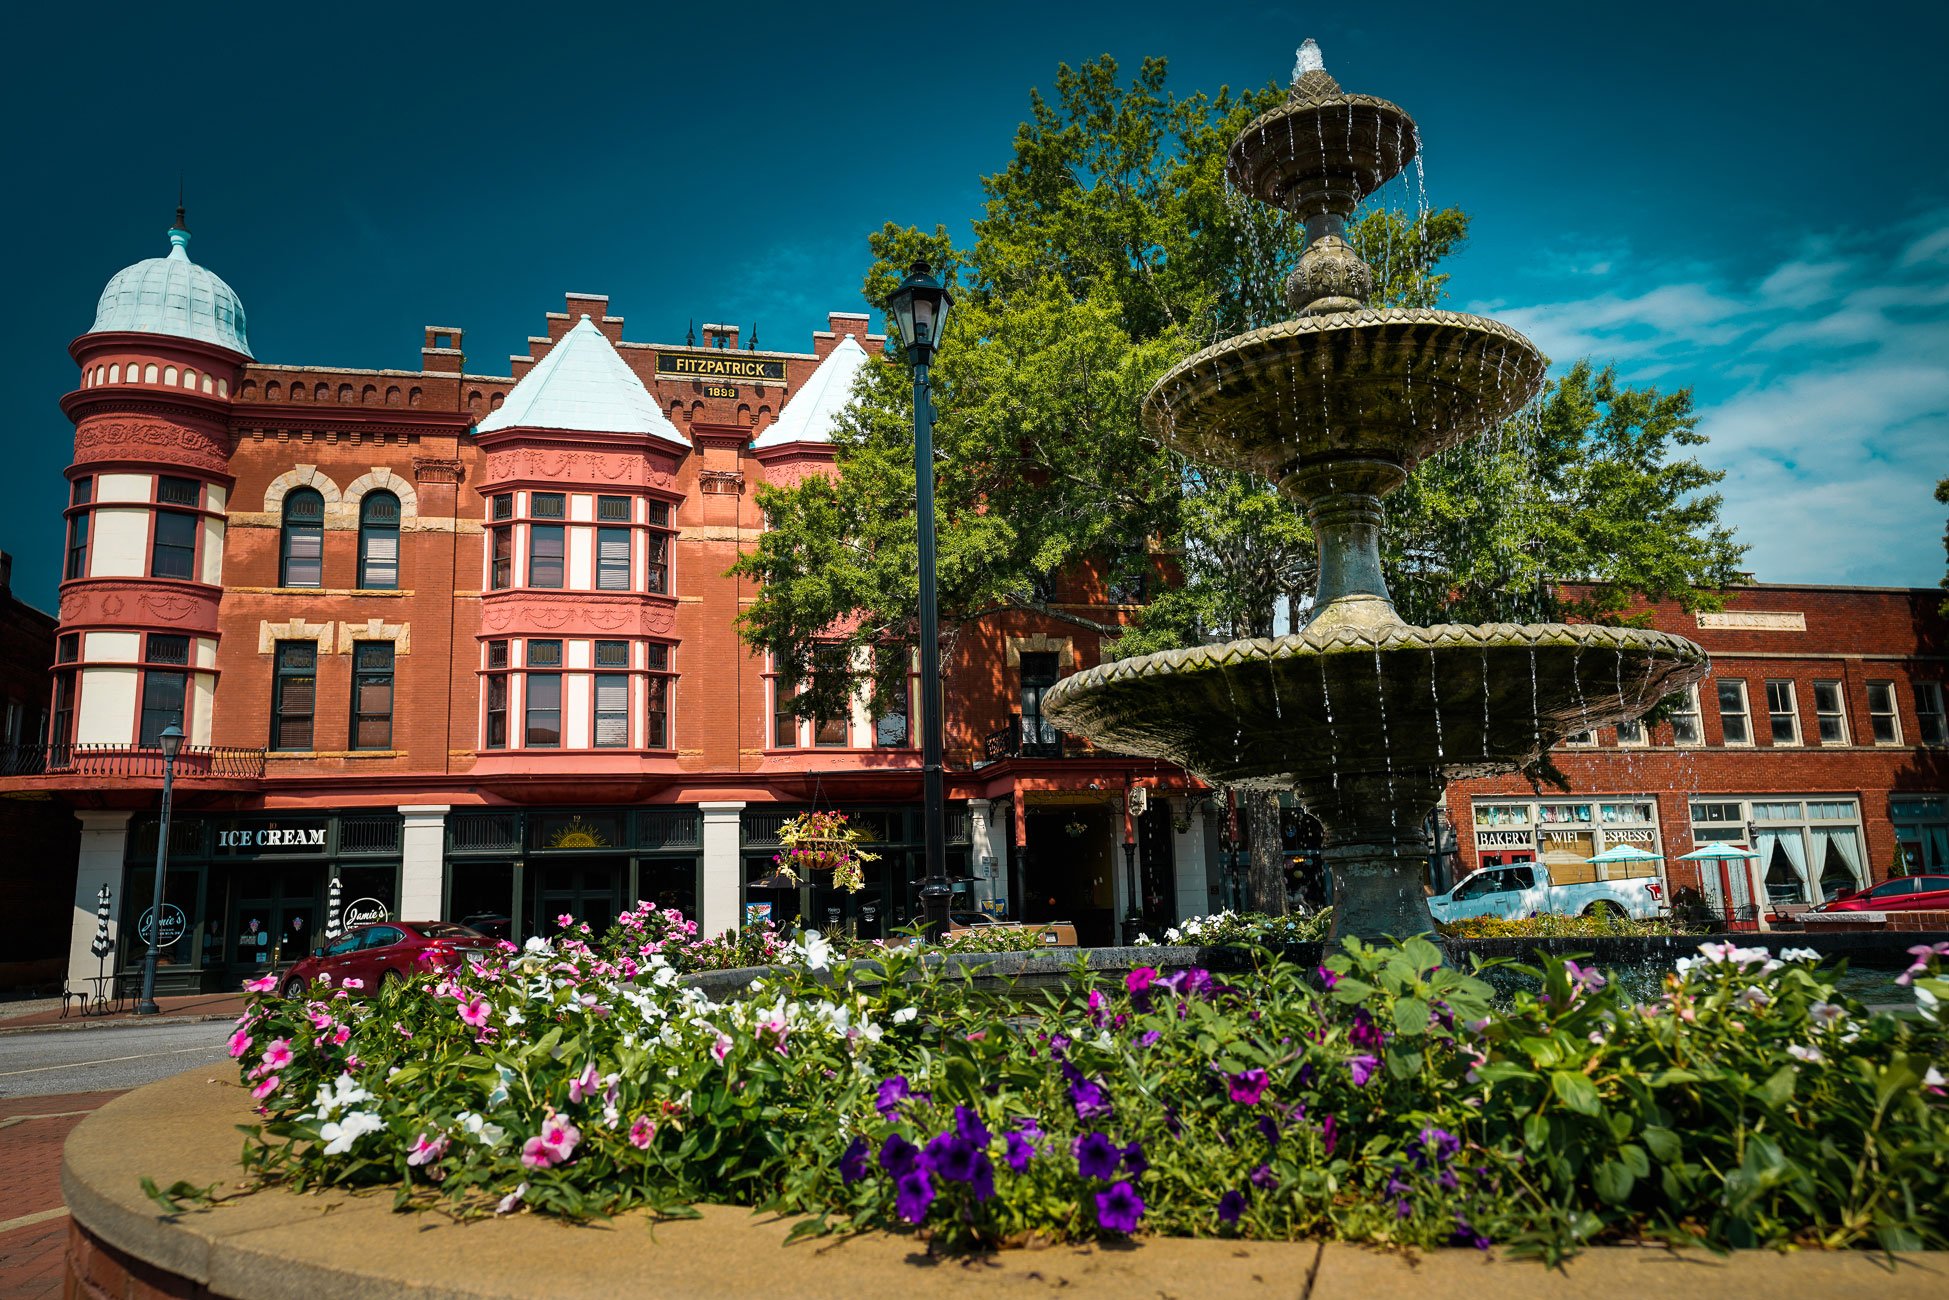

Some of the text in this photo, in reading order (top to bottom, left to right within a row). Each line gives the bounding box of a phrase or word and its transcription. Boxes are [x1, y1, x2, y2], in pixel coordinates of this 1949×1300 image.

[676, 358, 765, 376] FITZPATRICK
[708, 388, 735, 398] 1898
[218, 829, 327, 847] ICE CREAM
[1480, 832, 1528, 846] BAKERY
[1551, 831, 1579, 844] WIFI
[1603, 830, 1654, 843] ESPRESSO
[141, 911, 183, 932] Jmie's
[346, 905, 386, 926] Jamie's
